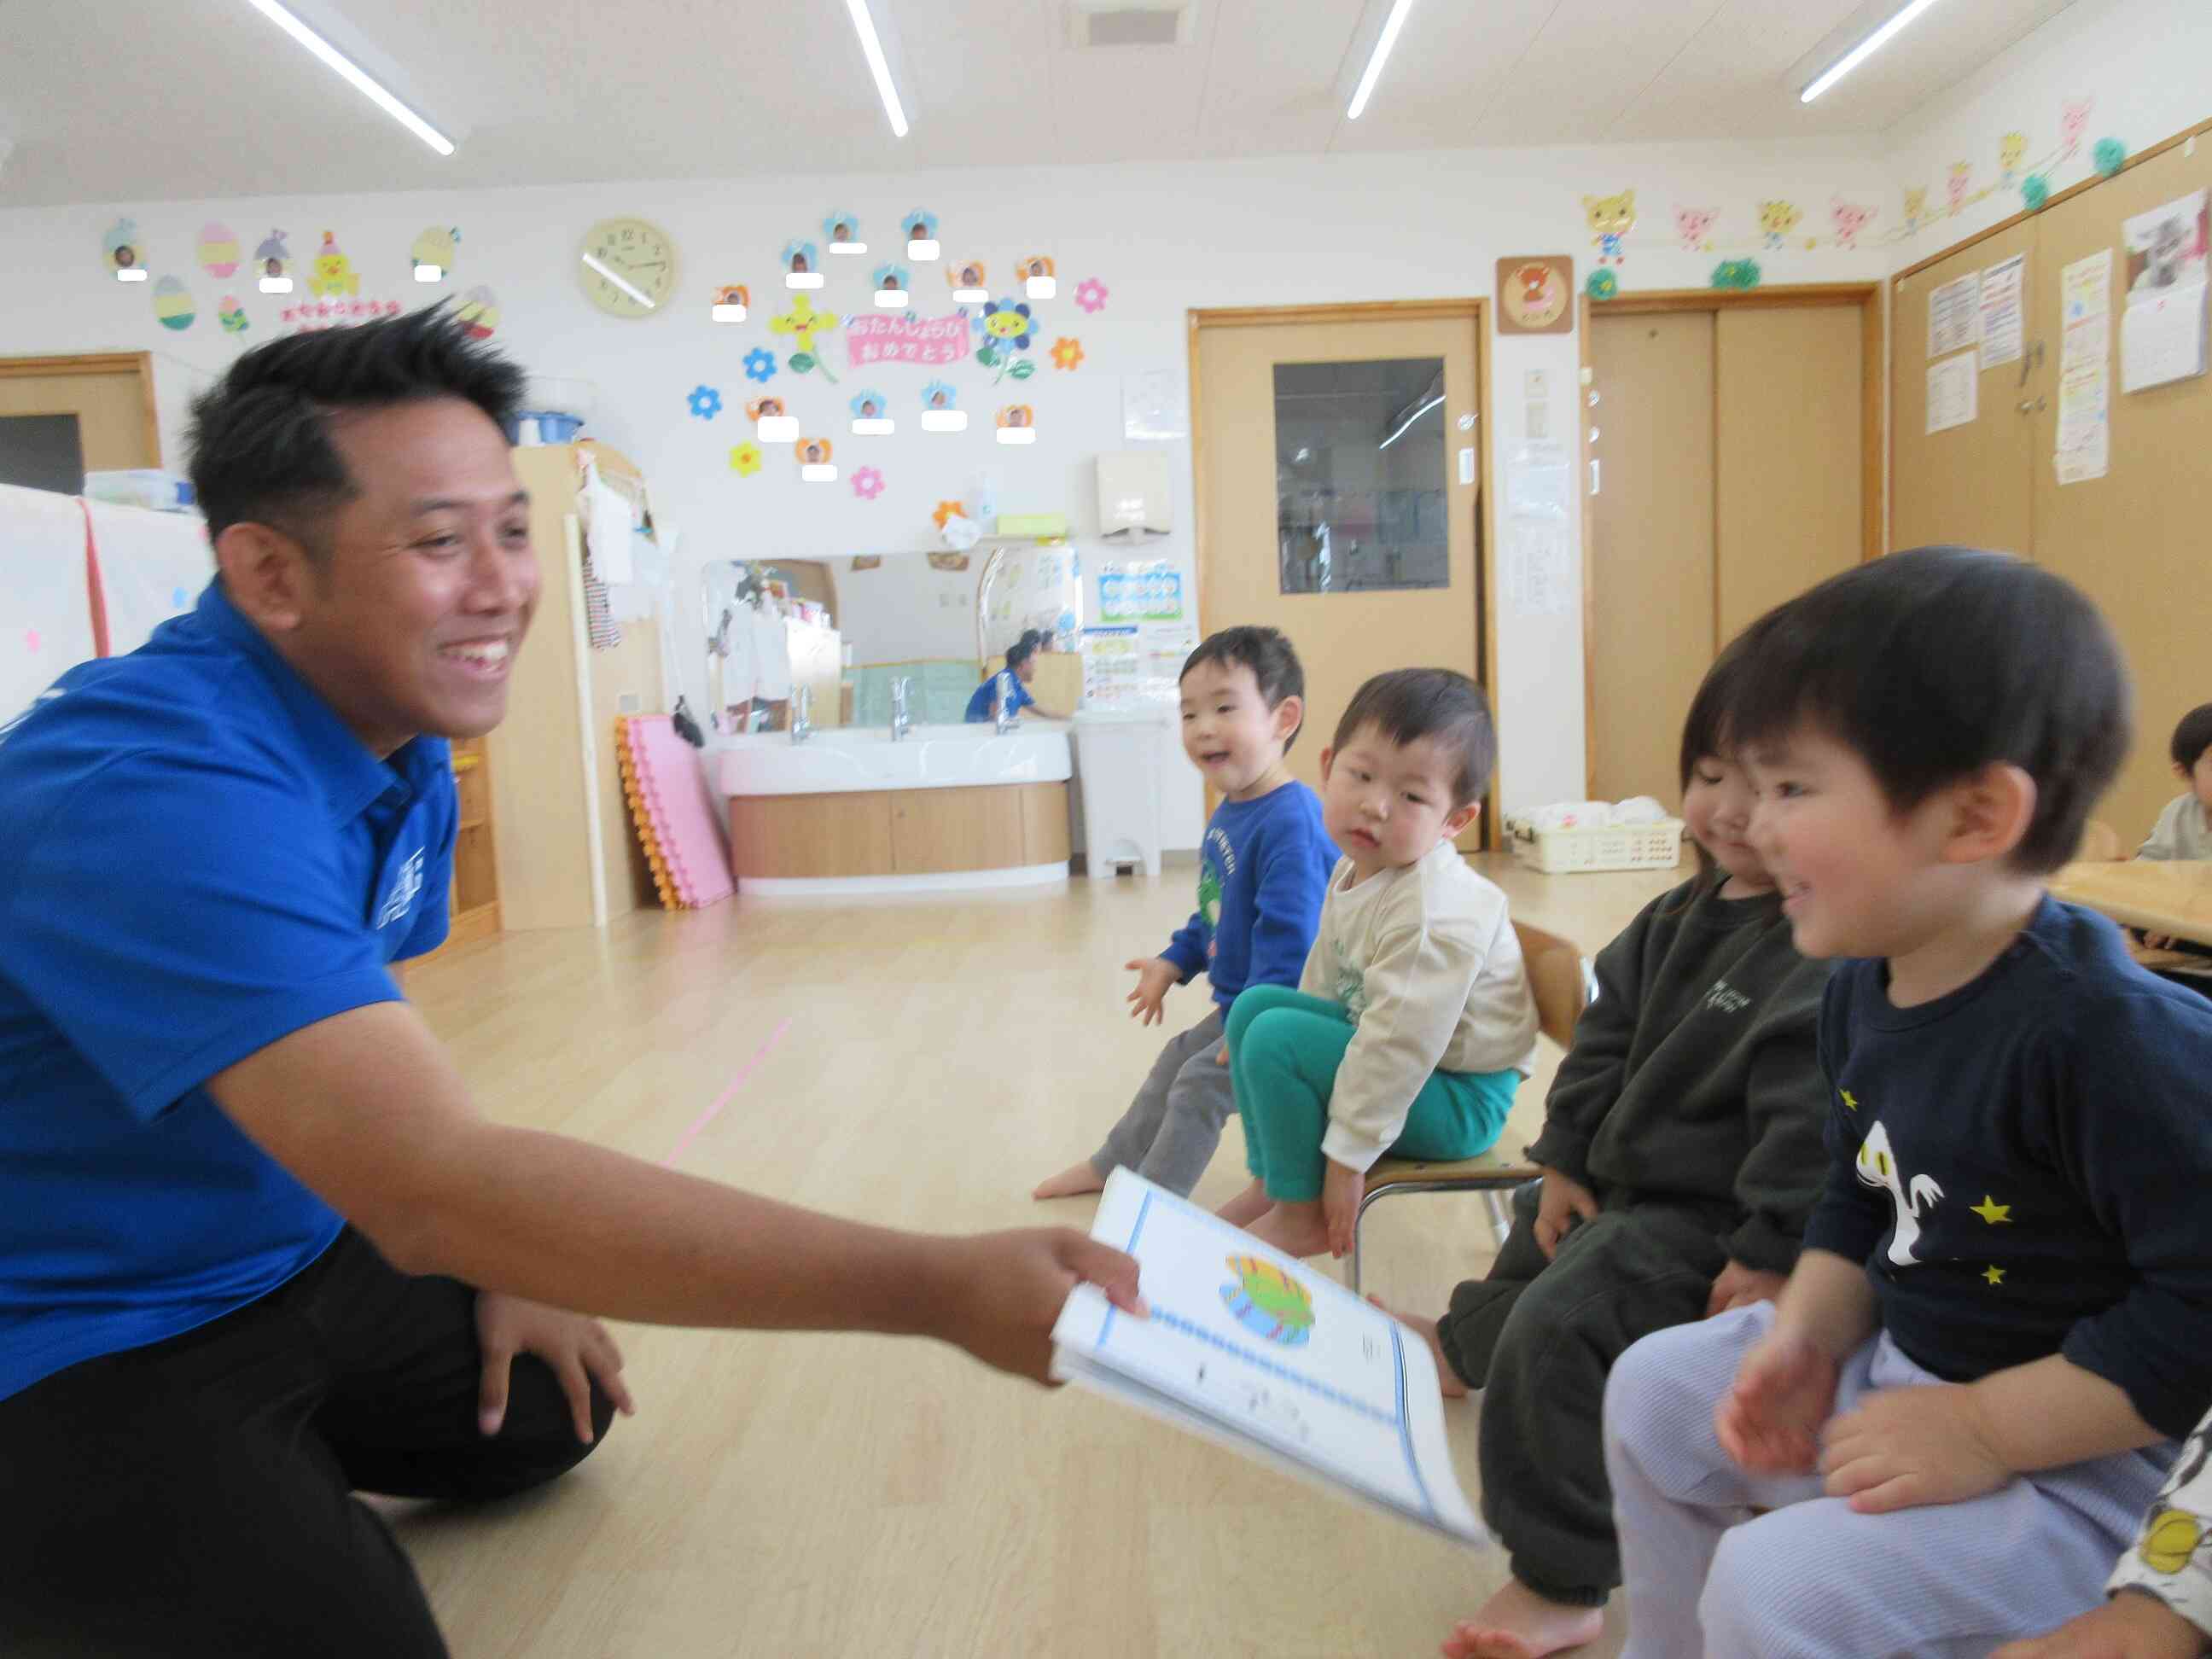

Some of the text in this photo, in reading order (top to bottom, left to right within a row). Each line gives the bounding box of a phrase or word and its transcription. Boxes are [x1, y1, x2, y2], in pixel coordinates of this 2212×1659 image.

[853, 317, 960, 340] おたんじょうび
[861, 341, 956, 362] おめでとう
